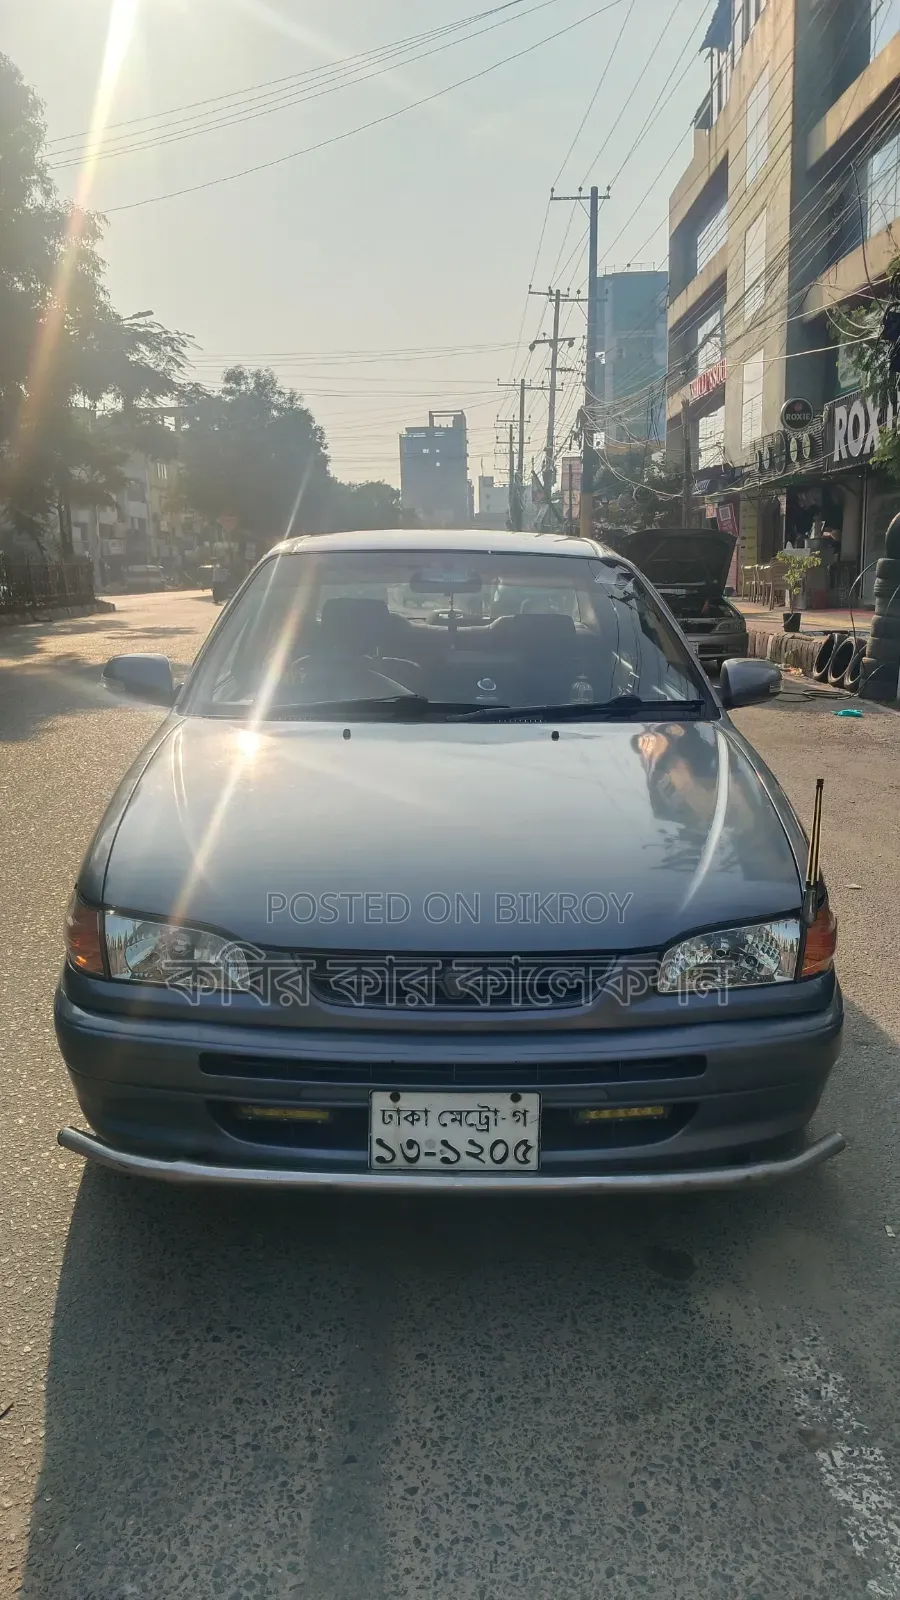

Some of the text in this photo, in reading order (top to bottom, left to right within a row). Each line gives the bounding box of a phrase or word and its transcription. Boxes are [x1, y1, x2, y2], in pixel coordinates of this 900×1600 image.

[785, 412, 811, 421] ROXIE
[380, 1106, 431, 1127] ঢাকা
[375, 1137, 534, 1165] ১৩-১২০৫
